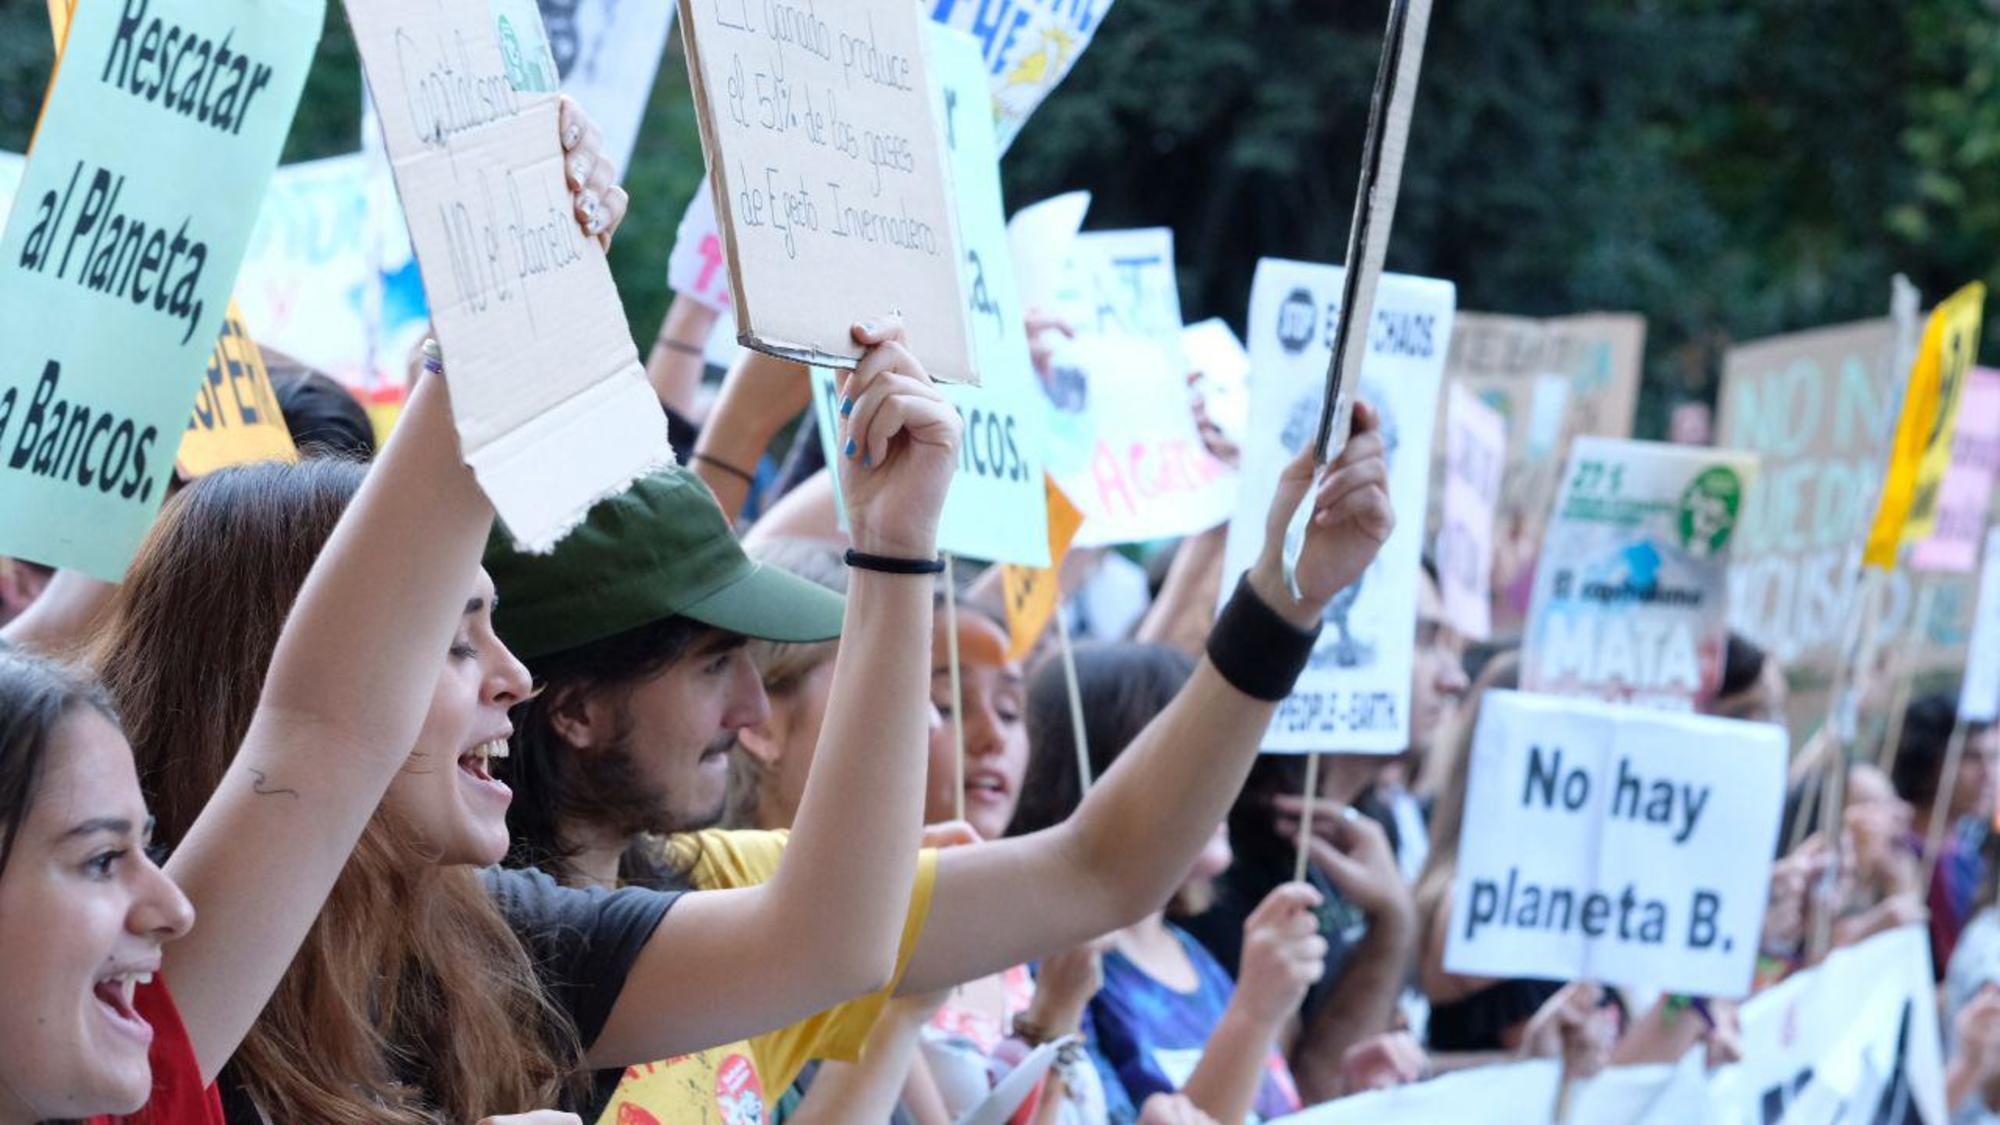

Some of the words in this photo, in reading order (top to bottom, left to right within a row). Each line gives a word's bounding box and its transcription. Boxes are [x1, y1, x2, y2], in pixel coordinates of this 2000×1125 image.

[101, 0, 273, 136] Rescatar
[839, 10, 912, 91] produce
[727, 52, 751, 128] el
[804, 82, 827, 146] de
[826, 88, 860, 160] los
[863, 130, 915, 198] gases
[739, 158, 765, 228] de
[19, 160, 84, 273] al
[57, 167, 207, 346] Planeta,
[8, 358, 157, 503] Bancos.
[1543, 609, 1700, 691] MATA
[1520, 745, 1592, 813] No
[1609, 756, 1712, 846] hay
[1463, 866, 1669, 943] planeta
[1686, 888, 1736, 954] B.
